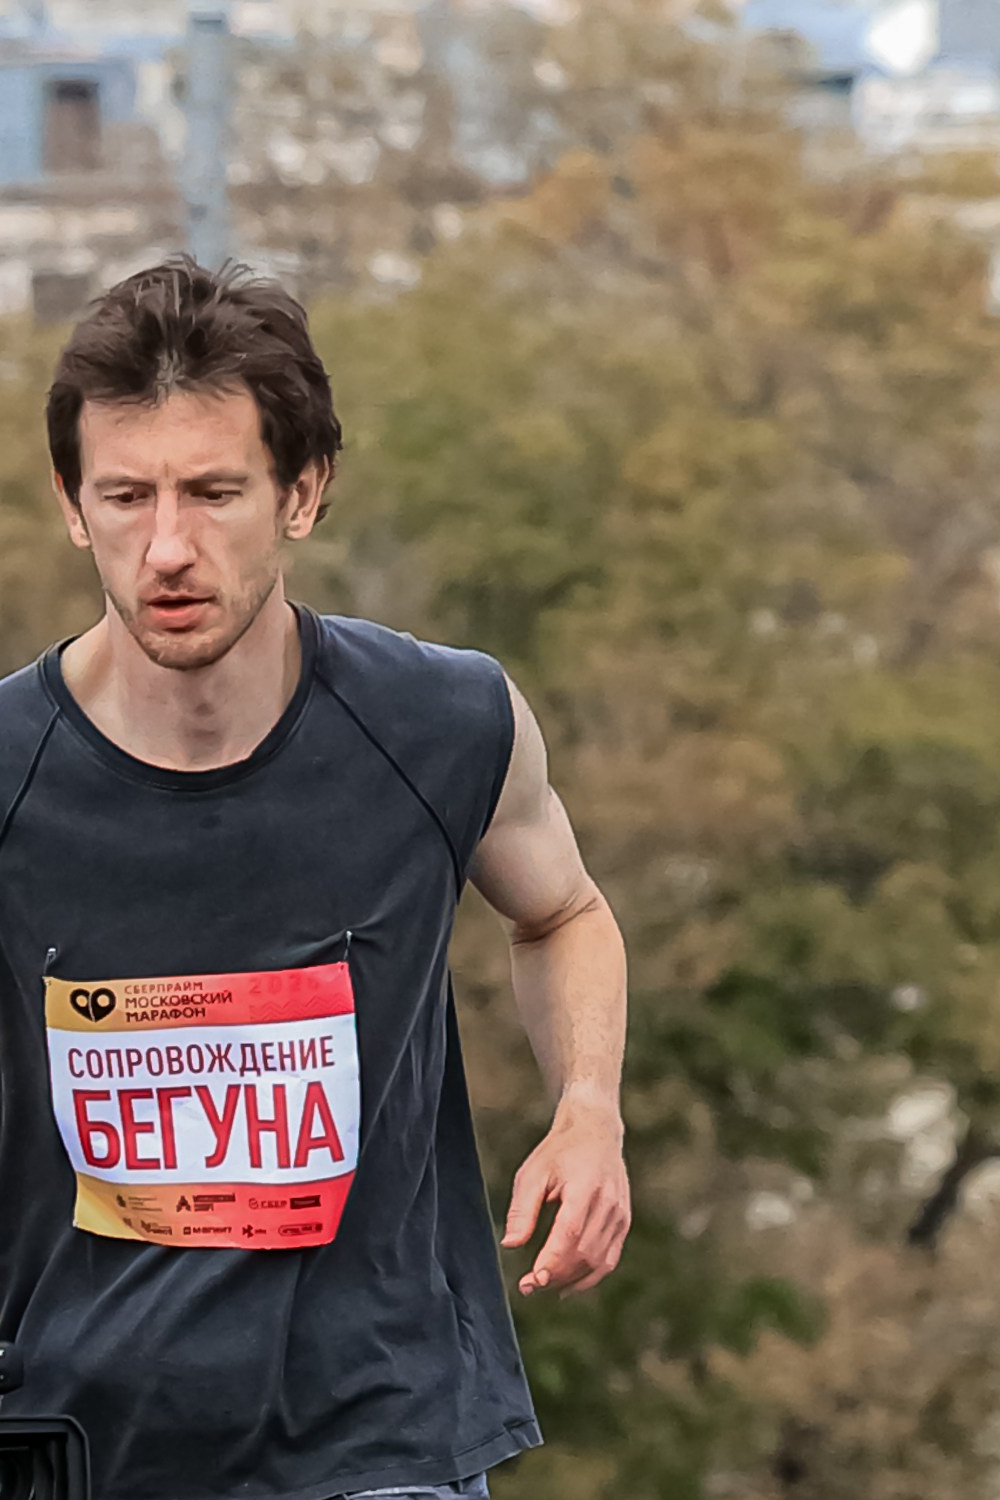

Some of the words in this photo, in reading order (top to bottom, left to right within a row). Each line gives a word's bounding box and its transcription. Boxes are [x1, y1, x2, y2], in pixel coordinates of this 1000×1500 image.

[124, 982, 203, 994] СБЕРПРАЙМ
[124, 989, 233, 1009] МОСКОВСКИЙ
[125, 1007, 206, 1022] МАРАФОН
[67, 1036, 335, 1079] СОПРОВОЖДЕНИЕ
[72, 1081, 345, 1170] БЕГУНА
